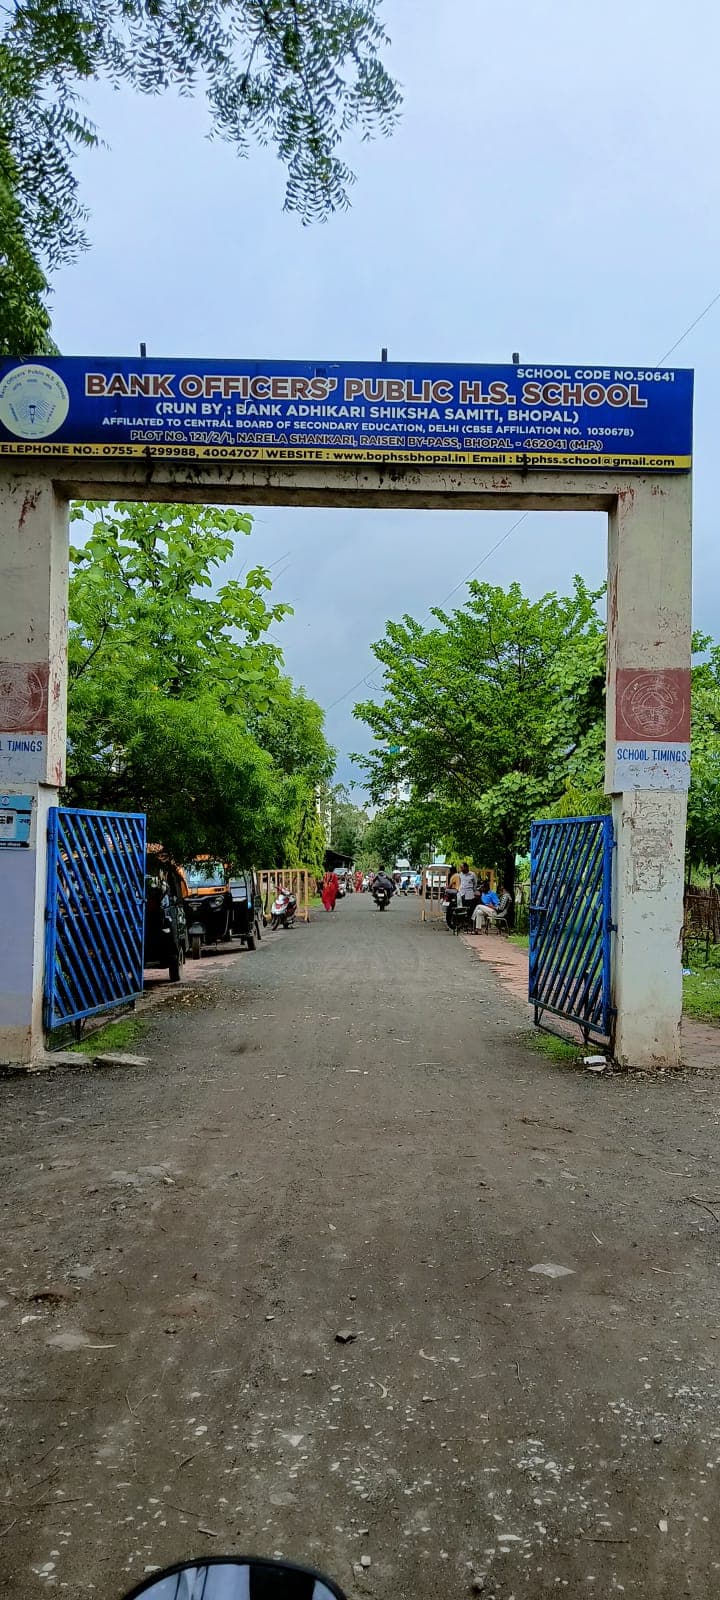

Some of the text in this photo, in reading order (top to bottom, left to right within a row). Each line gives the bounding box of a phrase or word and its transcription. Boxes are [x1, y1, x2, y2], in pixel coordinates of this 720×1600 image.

[516, 368, 675, 382] SCHOOL CODE NO.50641
[85, 372, 176, 398] BANK
[344, 378, 454, 403] PUBLIC
[460, 381, 516, 405] H.S.
[522, 382, 648, 408] SCHOOL
[156, 402, 197, 414] (RUN
[202, 403, 221, 414] BY
[236, 404, 282, 416] BANK
[286, 406, 365, 418] ADHIKARI
[370, 406, 440, 420] SHIKSHA
[444, 408, 503, 422] SAMITI,
[508, 410, 579, 424] BHOPAL)
[102, 417, 634, 437] AFFILIATED TO CENTRAL BOARD OF SECONDARY EDUCATION, DELHI (CBSE AFFILIATION NO. 1030678)
[130, 430, 163, 441] PLOT
[165, 432, 188, 442] NO.
[237, 432, 288, 443] NARELA
[289, 434, 358, 446] SHANKARI,
[360, 435, 406, 446] RAISEN
[408, 436, 462, 449] BY-PASS,
[464, 438, 512, 448] BHOPAL
[522, 439, 568, 449] 462041
[569, 440, 603, 450] (M.P.)
[0, 444, 69, 455] ELEPHONE
[74, 445, 98, 455] NO.:
[103, 445, 138, 455] 0755-
[203, 448, 259, 458] 4004707
[266, 450, 322, 459] WEBSITE
[334, 452, 466, 464] www.bophssbhopal.in
[472, 454, 506, 463] Email
[7, 740, 42, 752] TIMINGS
[617, 748, 687, 762] SCHOOL TIMINGS
